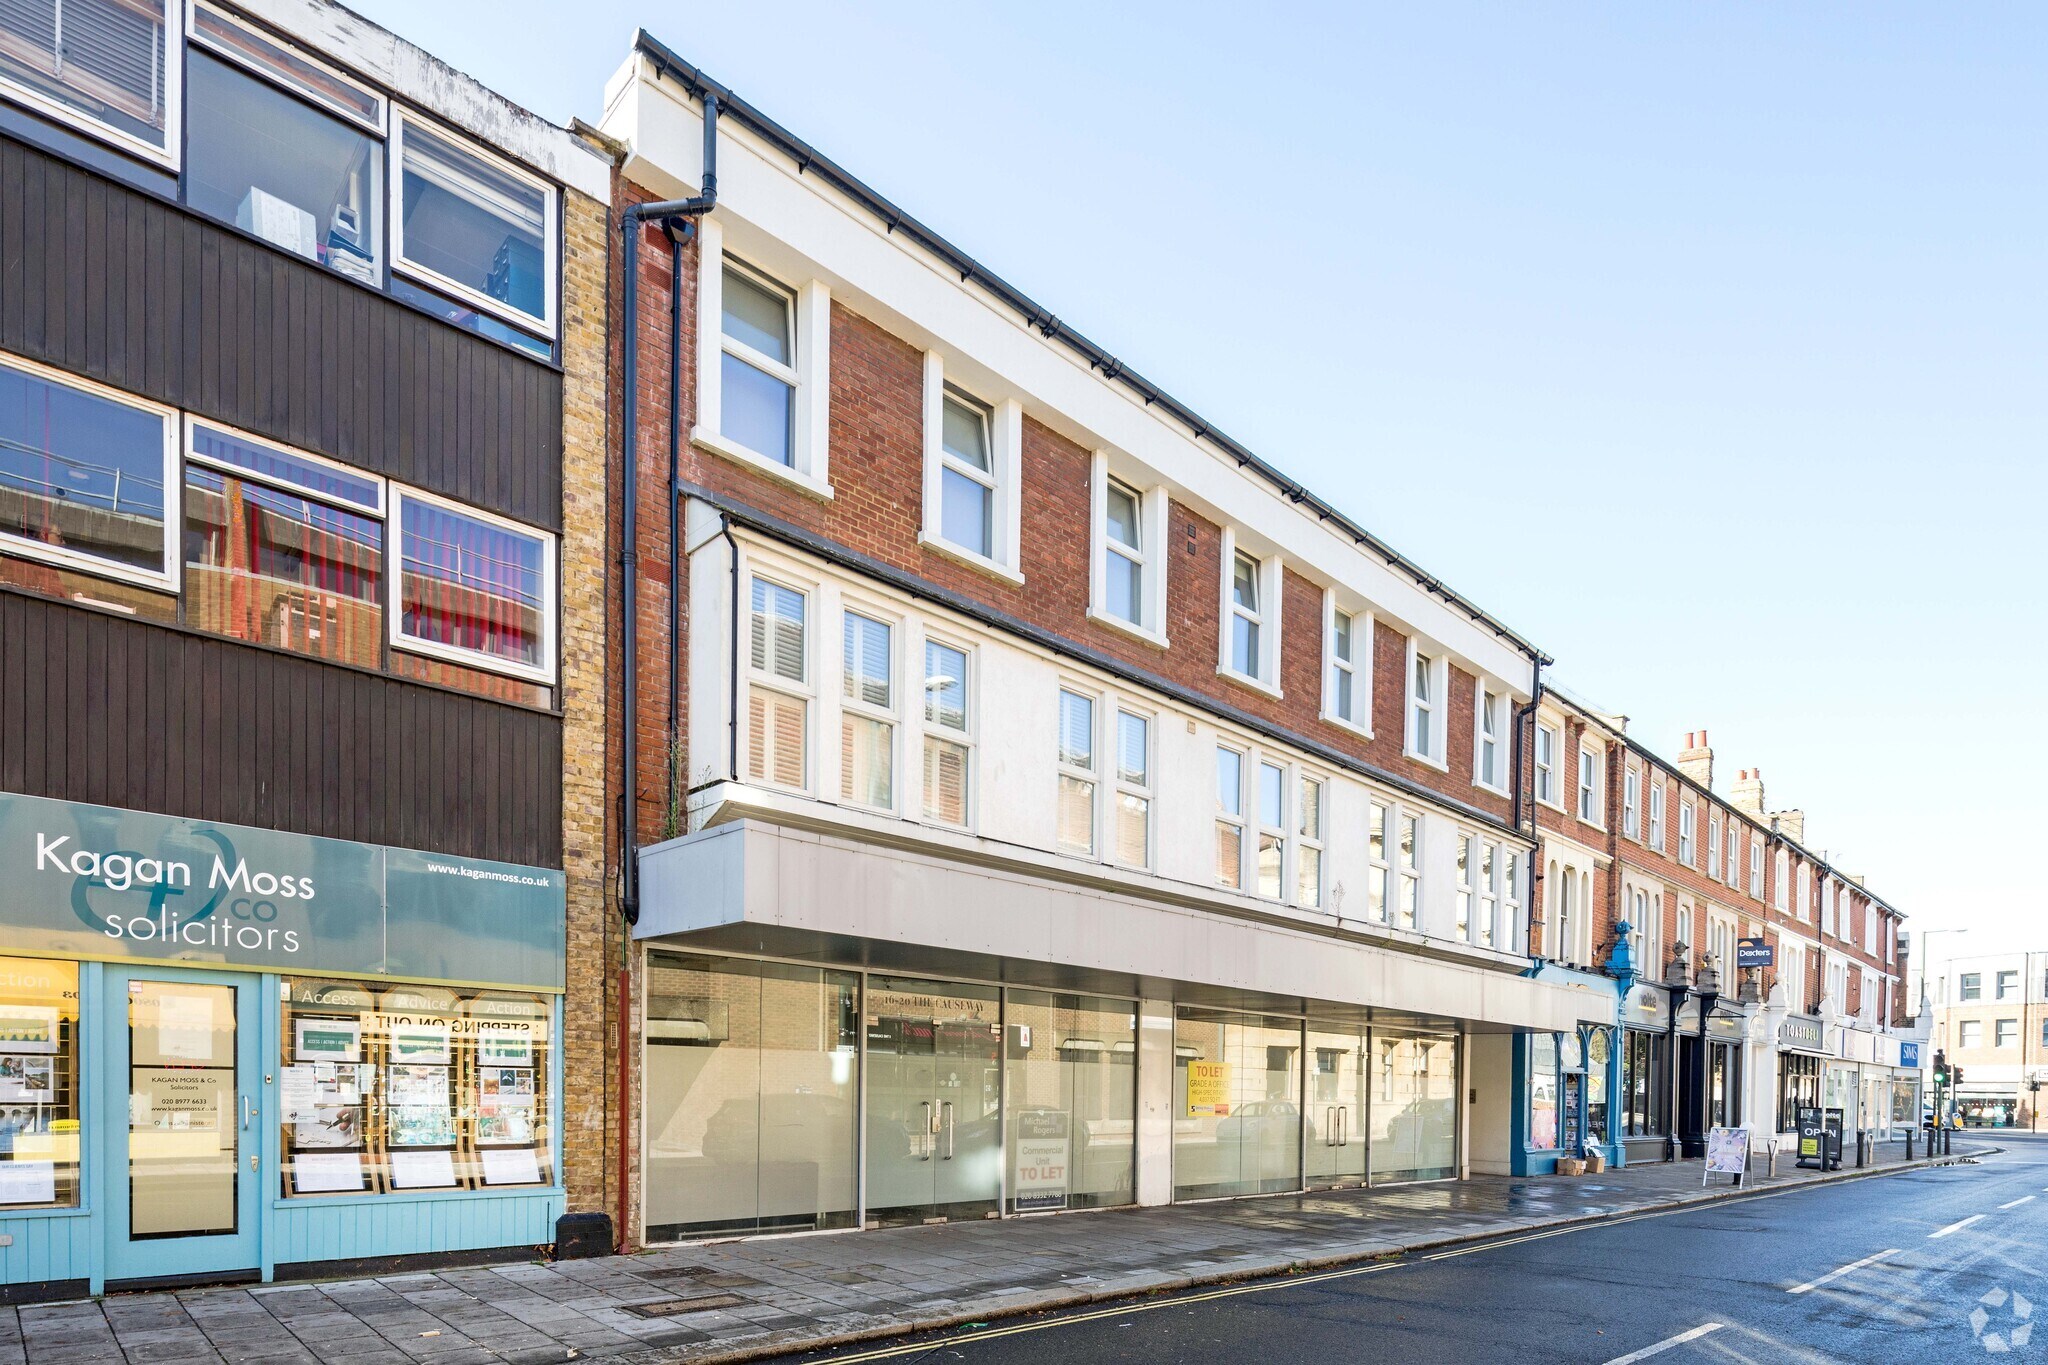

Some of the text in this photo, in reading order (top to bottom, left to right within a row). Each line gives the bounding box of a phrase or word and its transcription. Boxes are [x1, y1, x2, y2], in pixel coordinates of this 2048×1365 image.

[36, 832, 316, 900] Kagan Moss
[427, 863, 550, 888] www.kaganmoss.co.uk
[104, 903, 300, 953] solicitors
[1739, 949, 1771, 957] Dexters
[301, 989, 357, 1006] Access
[397, 993, 449, 1010] Advice
[884, 995, 985, 1012] 16-20 THE CAUSEWAY
[486, 1001, 531, 1016] Action
[1903, 1044, 1918, 1060] SIMS
[1196, 1066, 1224, 1077] TO LET
[1024, 1117, 1050, 1126] Michael
[1033, 1126, 1056, 1136] Rogers
[1804, 1127, 1837, 1138] OPN
[1022, 1146, 1064, 1155] Commercial
[1035, 1157, 1050, 1166] Unit
[1019, 1166, 1065, 1181] TO LET
